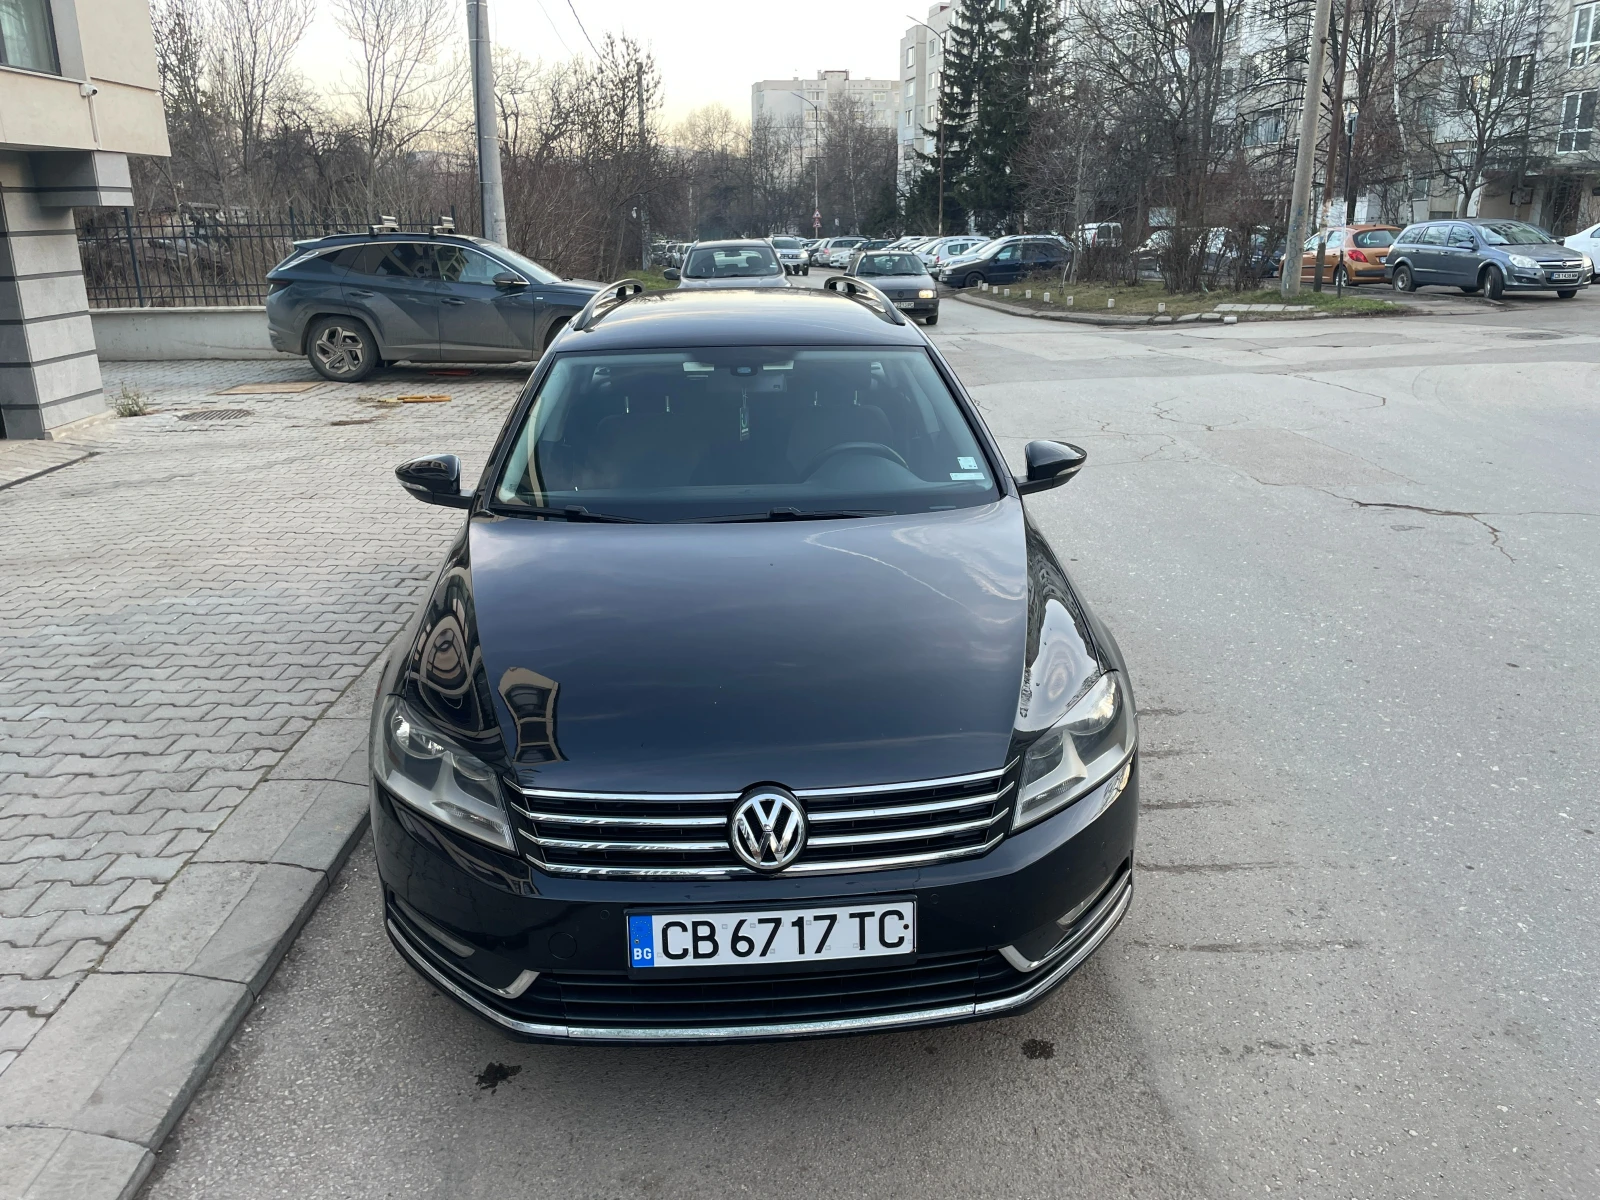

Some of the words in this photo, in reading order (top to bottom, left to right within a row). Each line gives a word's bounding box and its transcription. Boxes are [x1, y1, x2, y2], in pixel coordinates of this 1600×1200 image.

[733, 794, 805, 868] VW
[634, 948, 652, 960] BG
[661, 920, 719, 960] CB
[730, 914, 838, 958] 6717
[849, 909, 905, 950] TC
